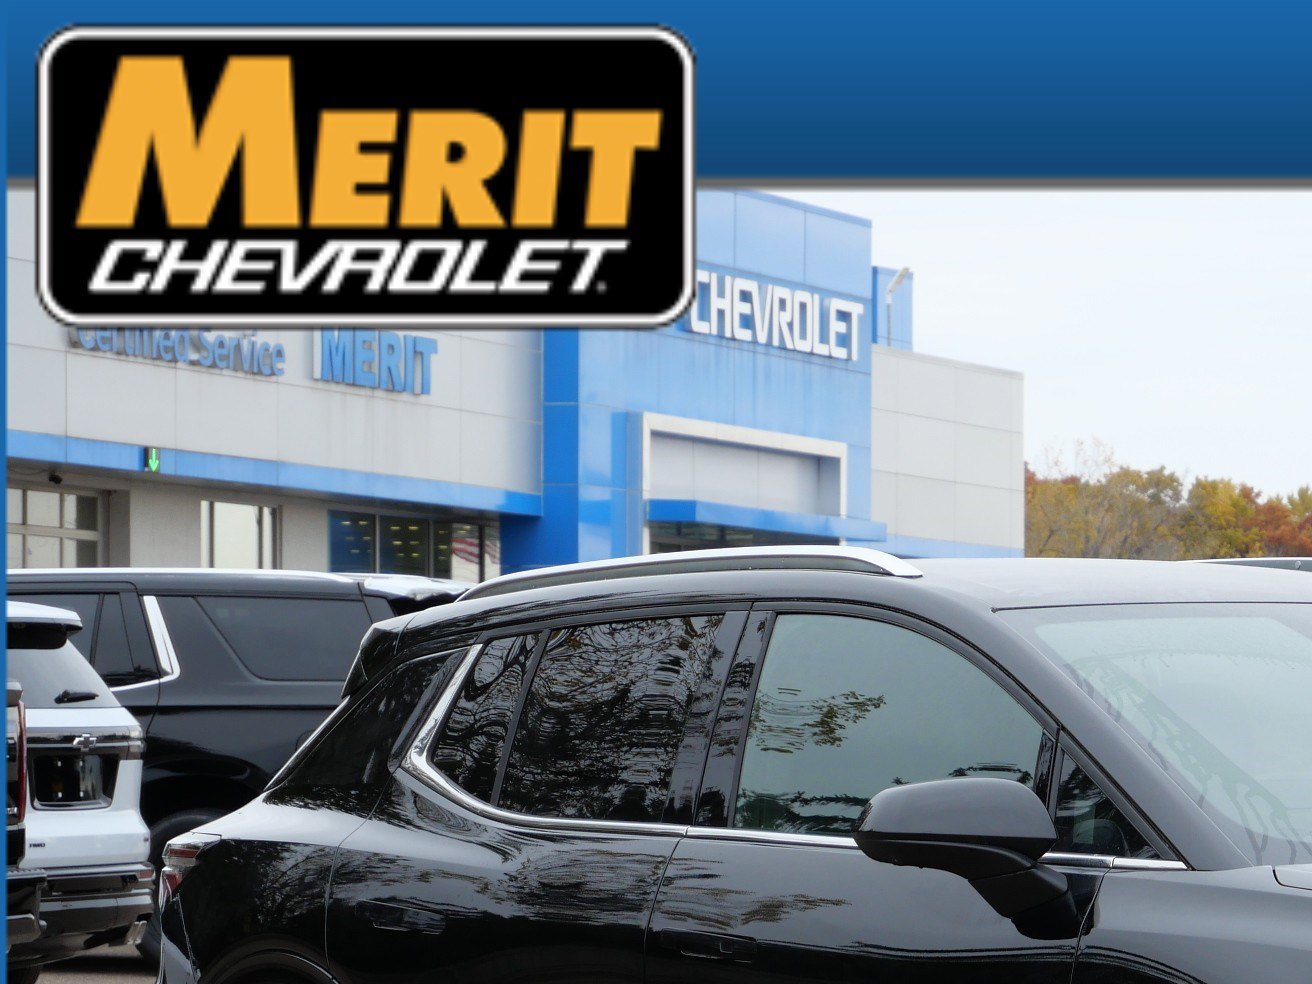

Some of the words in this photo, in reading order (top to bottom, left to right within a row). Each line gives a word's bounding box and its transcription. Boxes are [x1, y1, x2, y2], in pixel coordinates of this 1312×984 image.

[691, 269, 864, 361] CHEVROLET
[199, 328, 286, 376] Service
[320, 328, 438, 395] MERIT
